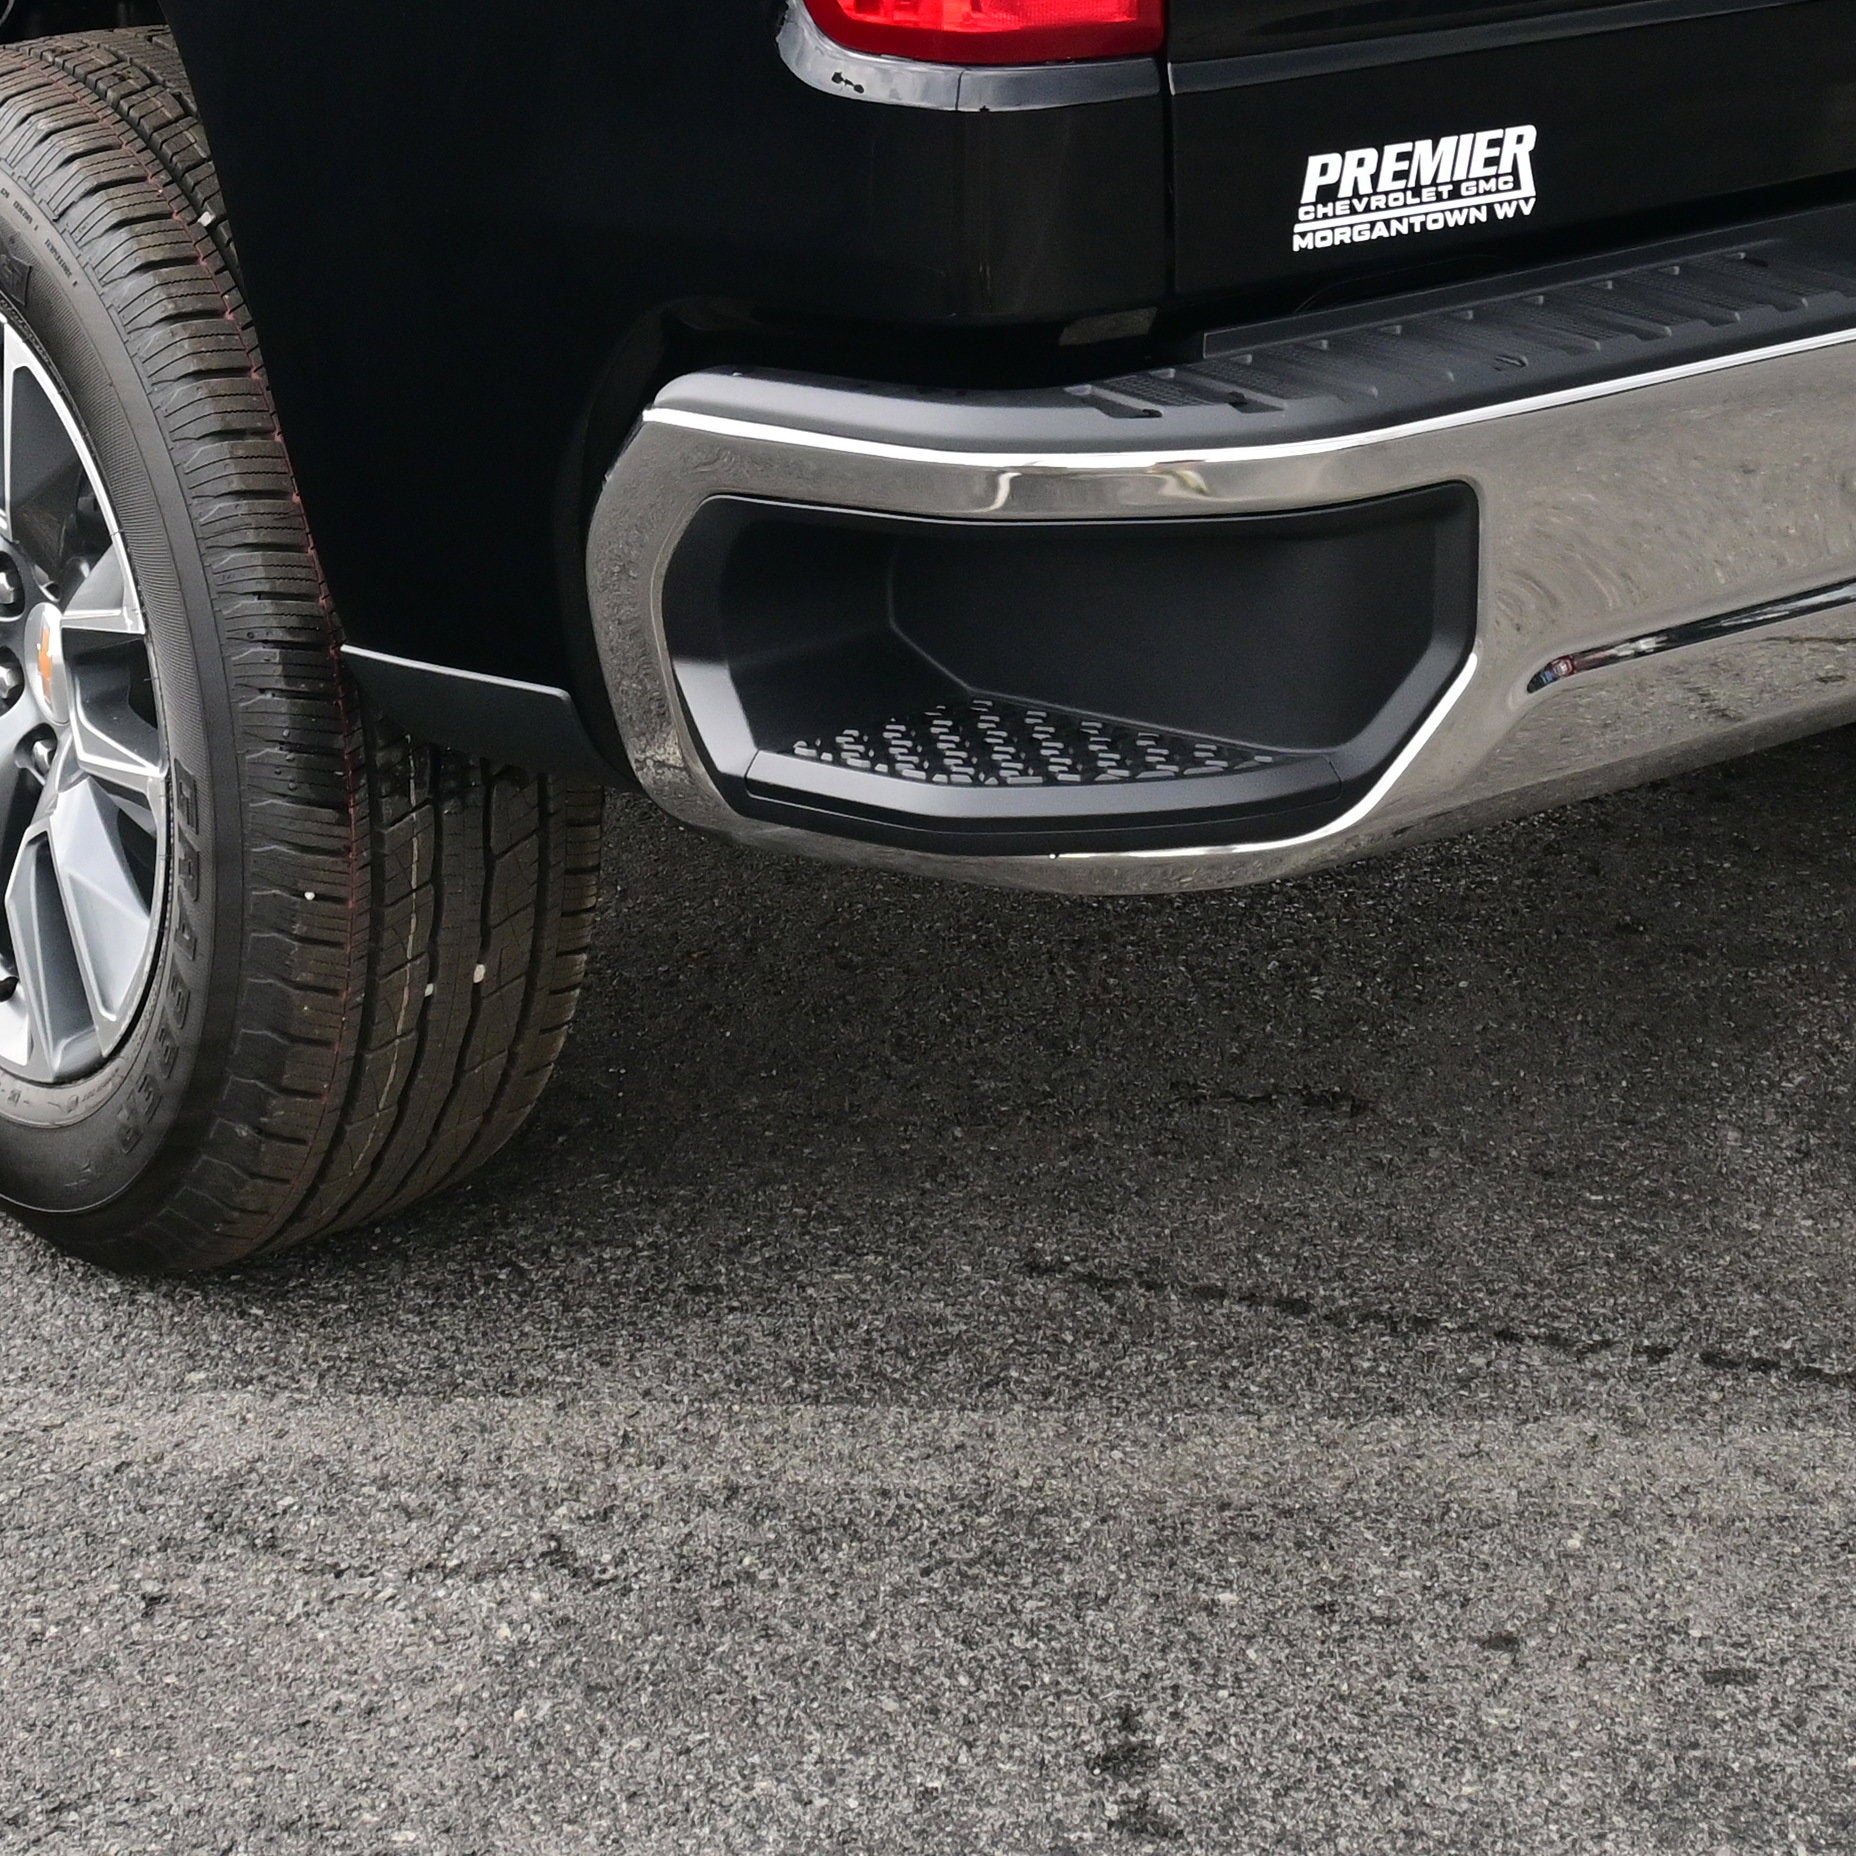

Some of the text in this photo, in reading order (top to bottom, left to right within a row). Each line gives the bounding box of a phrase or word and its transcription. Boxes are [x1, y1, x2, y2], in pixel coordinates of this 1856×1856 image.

[1300, 124, 1537, 204] PREMIER
[1292, 197, 1537, 252] MORGANTOWN WV
[1297, 175, 1515, 221] CHEVROLET GMC
